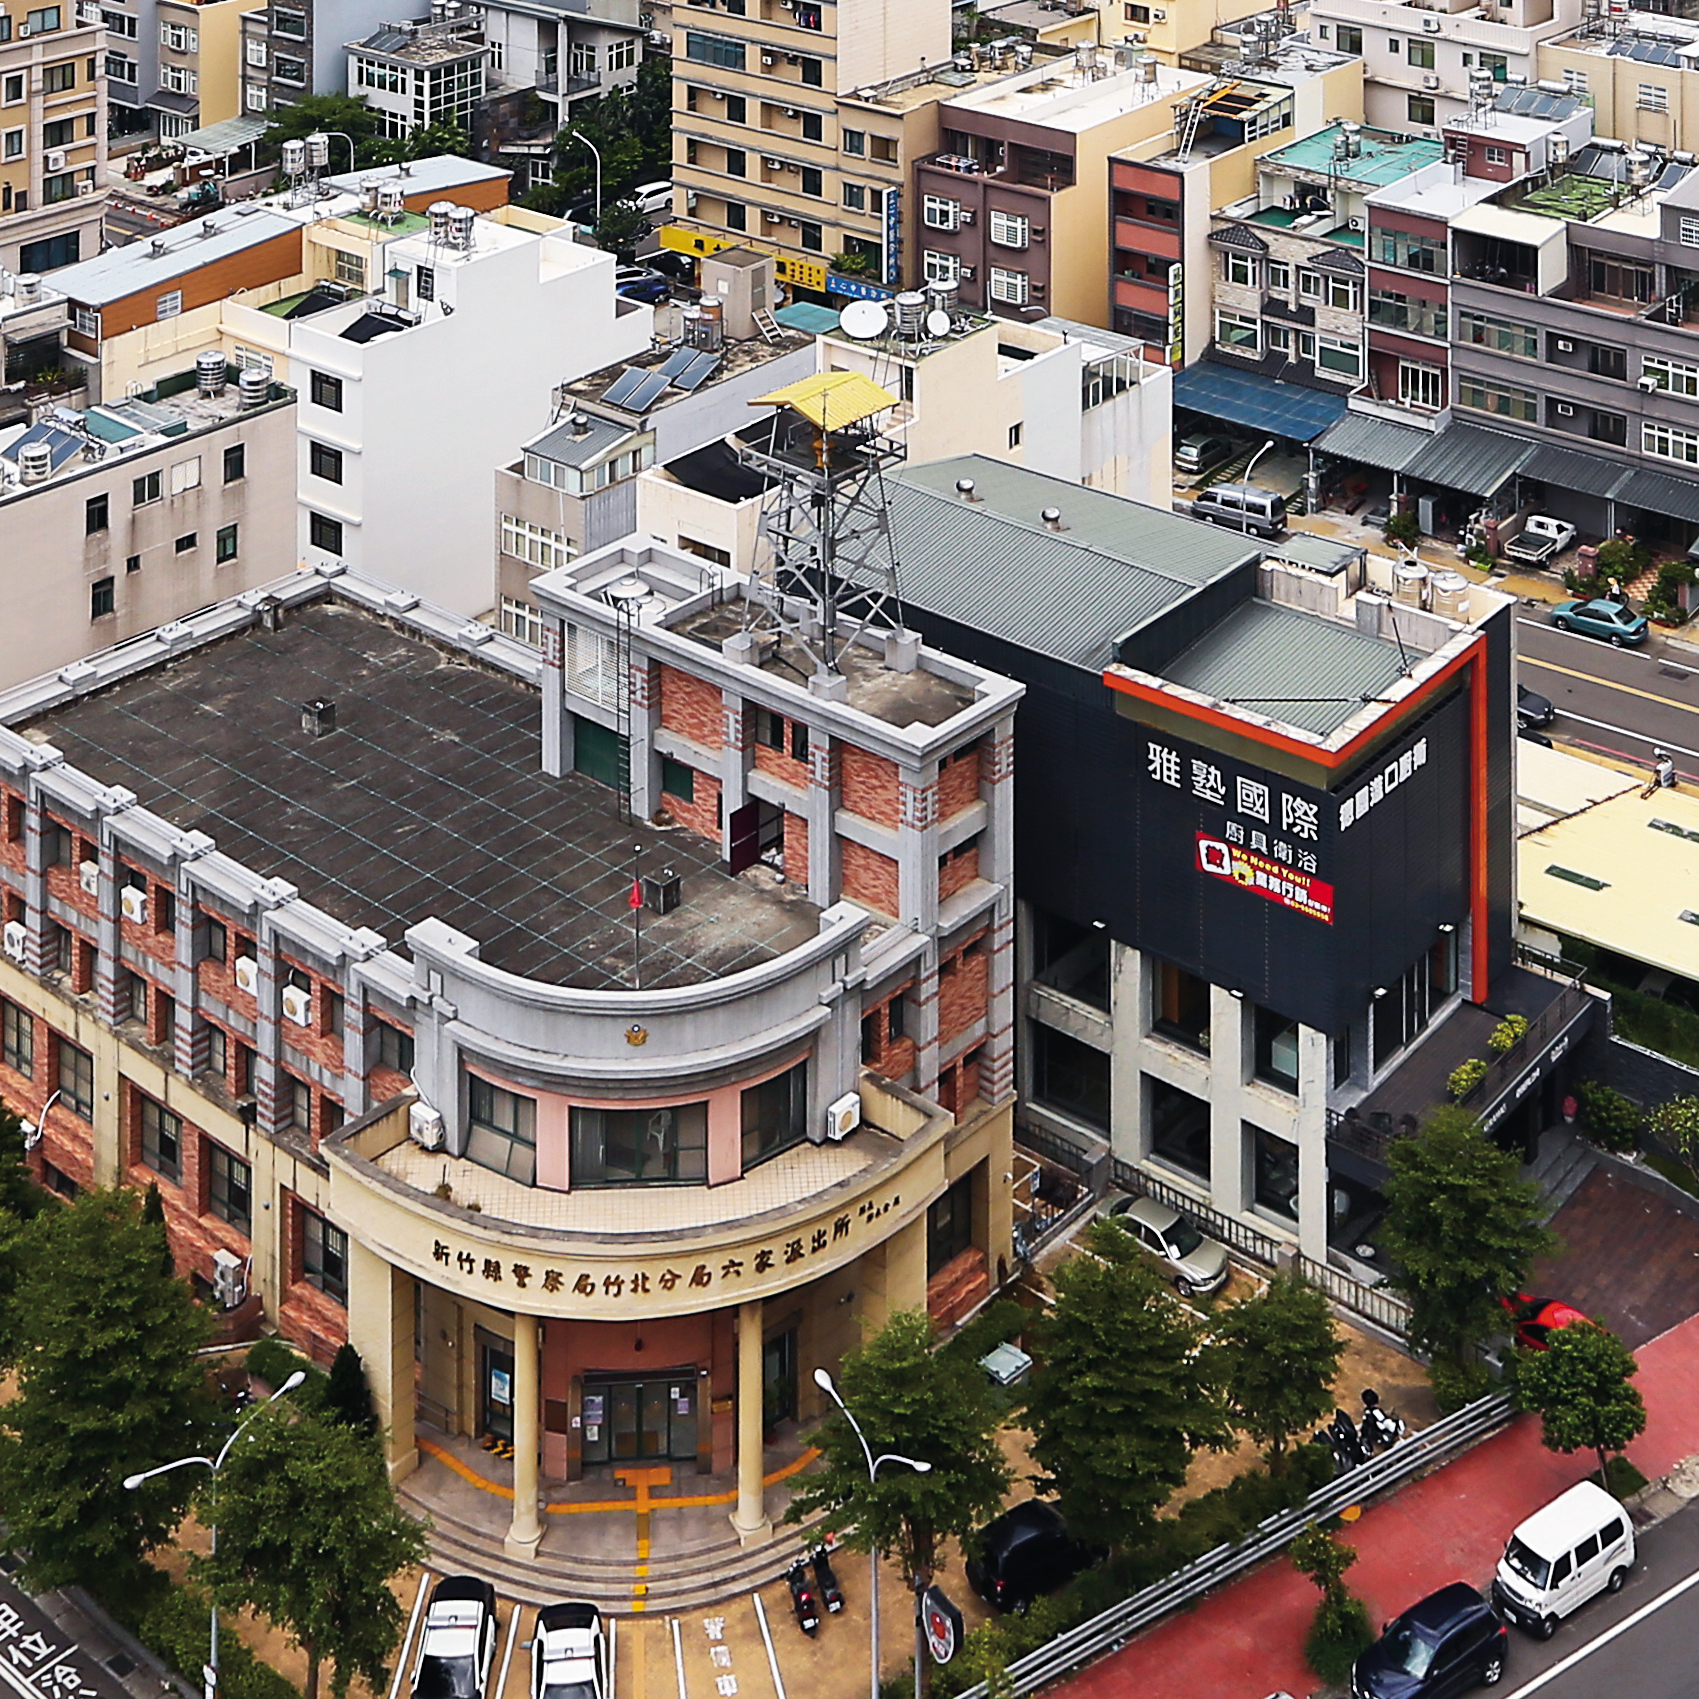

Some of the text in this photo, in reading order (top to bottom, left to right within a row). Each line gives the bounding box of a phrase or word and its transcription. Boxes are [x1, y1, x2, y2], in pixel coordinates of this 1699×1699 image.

[1148, 742, 1319, 841] 雅塾國際
[1231, 848, 1248, 861] We
[1250, 855, 1279, 874] Need
[432, 1214, 852, 1297] 新竹縣警察局竹北分局六家派出所
